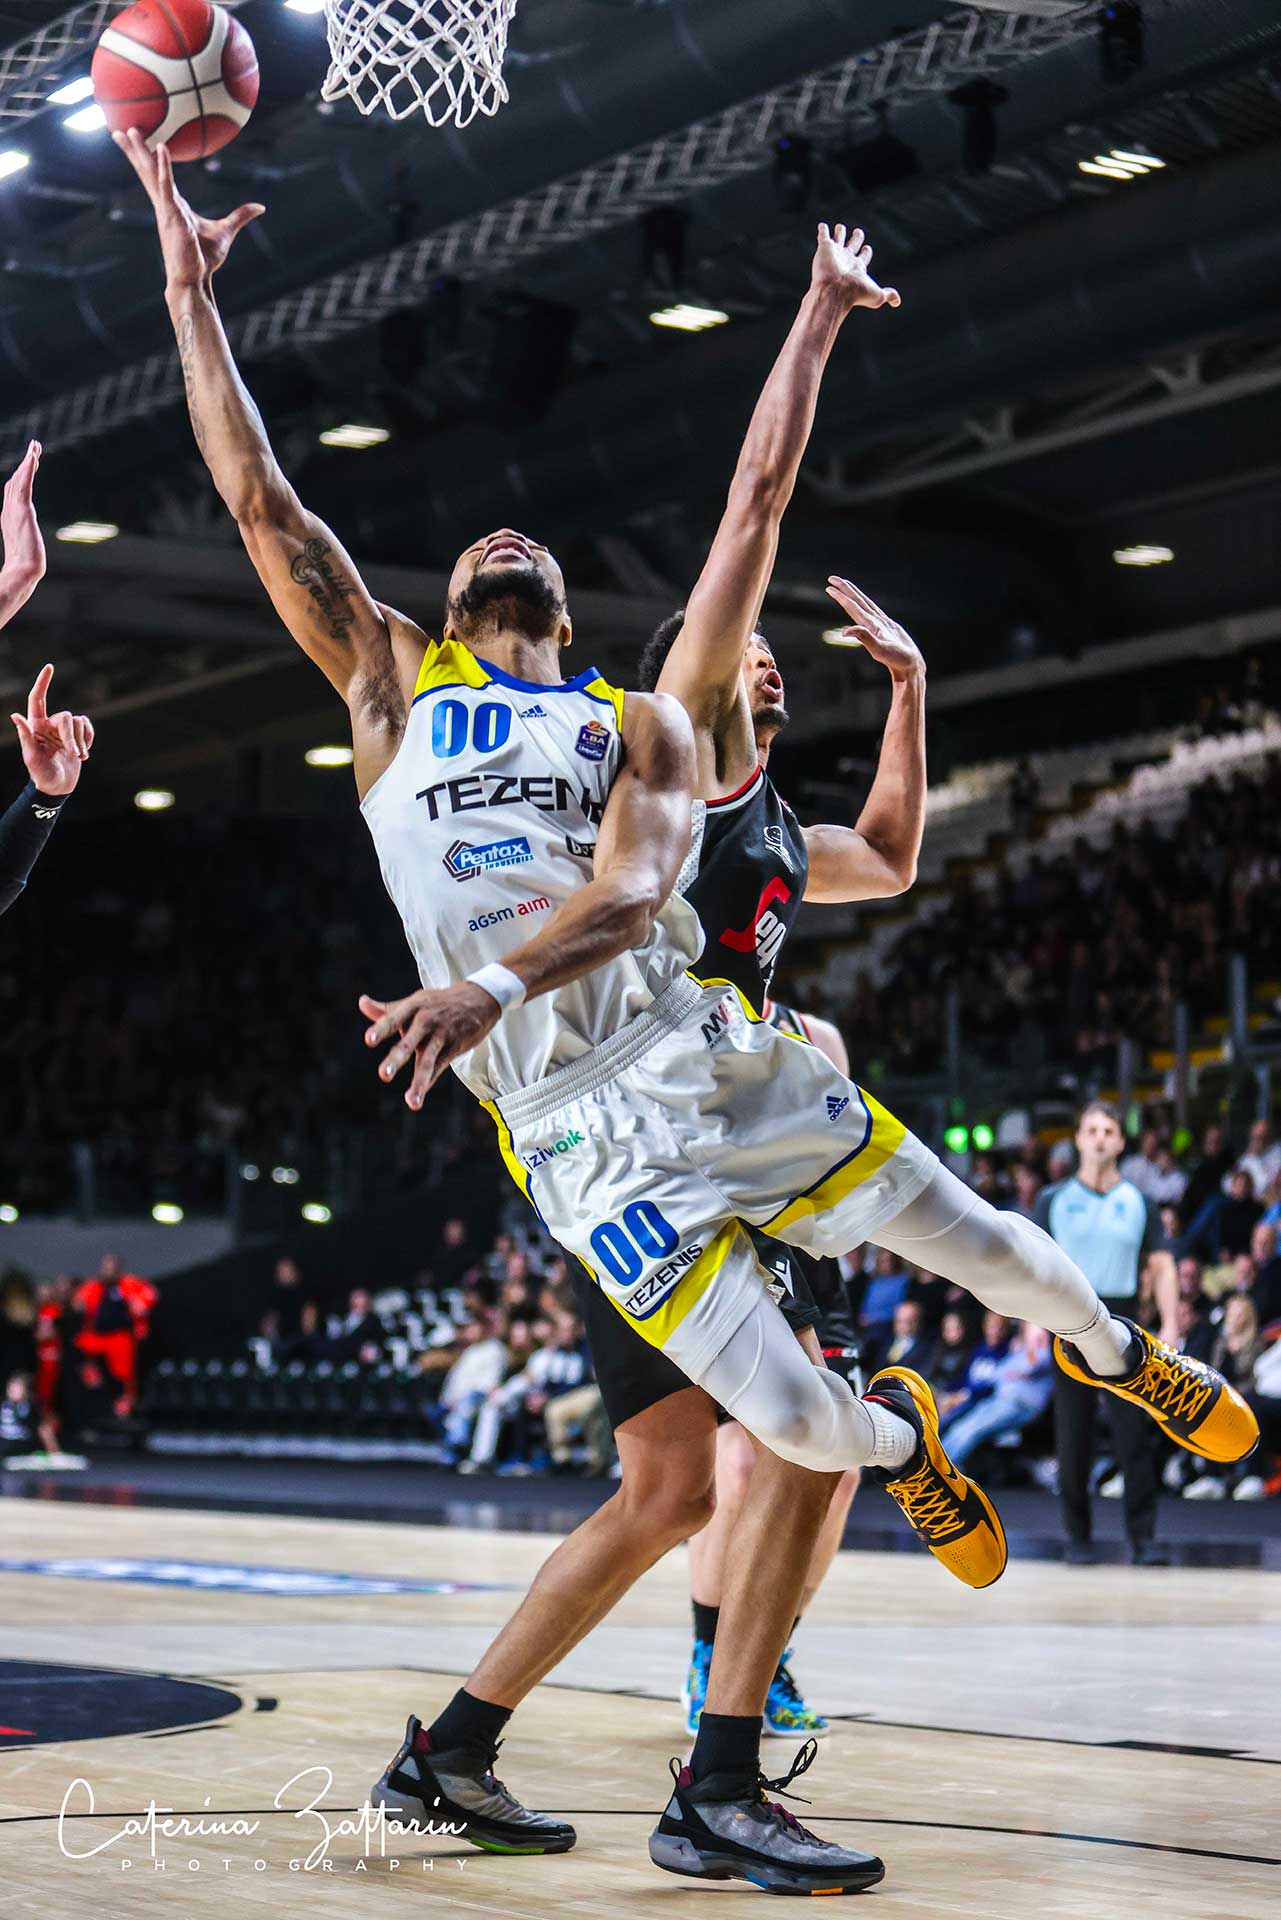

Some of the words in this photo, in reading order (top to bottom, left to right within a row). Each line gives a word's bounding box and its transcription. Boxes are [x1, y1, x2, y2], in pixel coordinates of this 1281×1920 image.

[431, 699, 512, 758] 00
[460, 843, 525, 868] Pentax
[517, 896, 550, 916] aim
[590, 1200, 679, 1286] 00
[625, 1244, 703, 1312] TEZENIS
